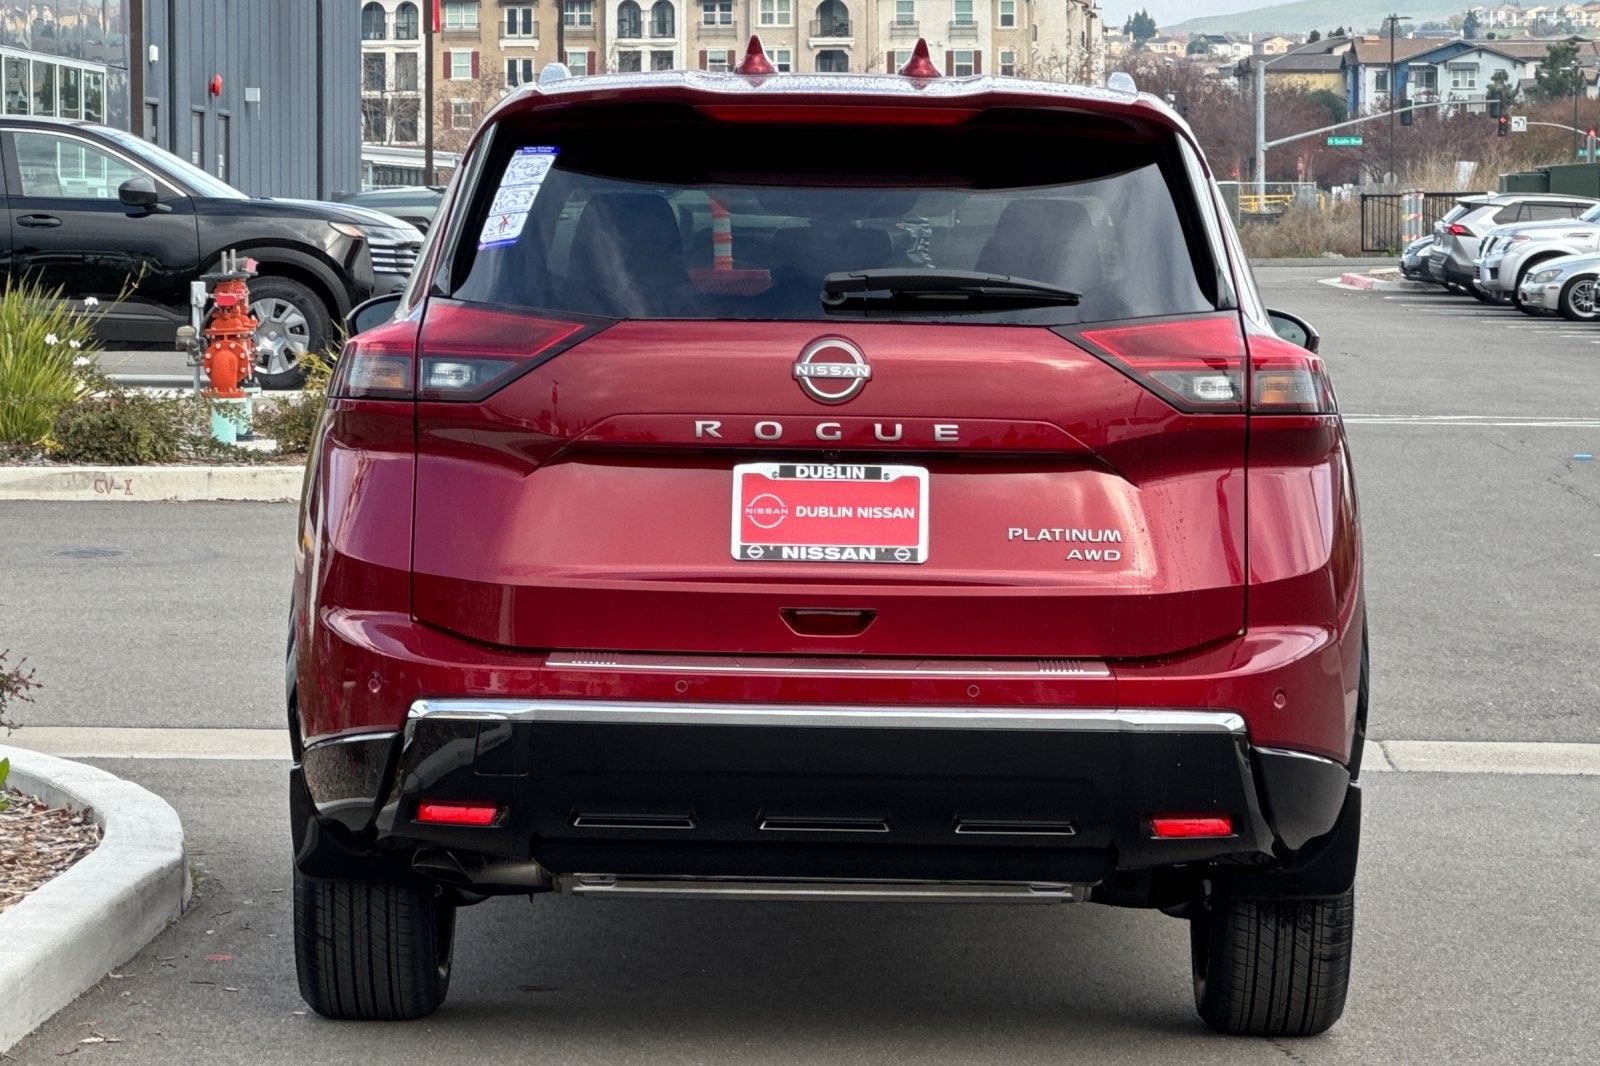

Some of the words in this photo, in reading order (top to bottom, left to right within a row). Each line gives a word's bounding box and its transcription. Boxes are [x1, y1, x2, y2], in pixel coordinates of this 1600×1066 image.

[796, 365, 869, 377] NISSAN
[694, 420, 960, 442] ROGUE
[795, 465, 865, 479] DUBLIN
[745, 507, 788, 515] NISSAN
[795, 505, 853, 518] DUBLIN
[857, 506, 915, 519] NISSAN
[1008, 527, 1122, 542] PLATINUM
[782, 546, 876, 561] NISSAN
[1066, 549, 1121, 561] AWD
